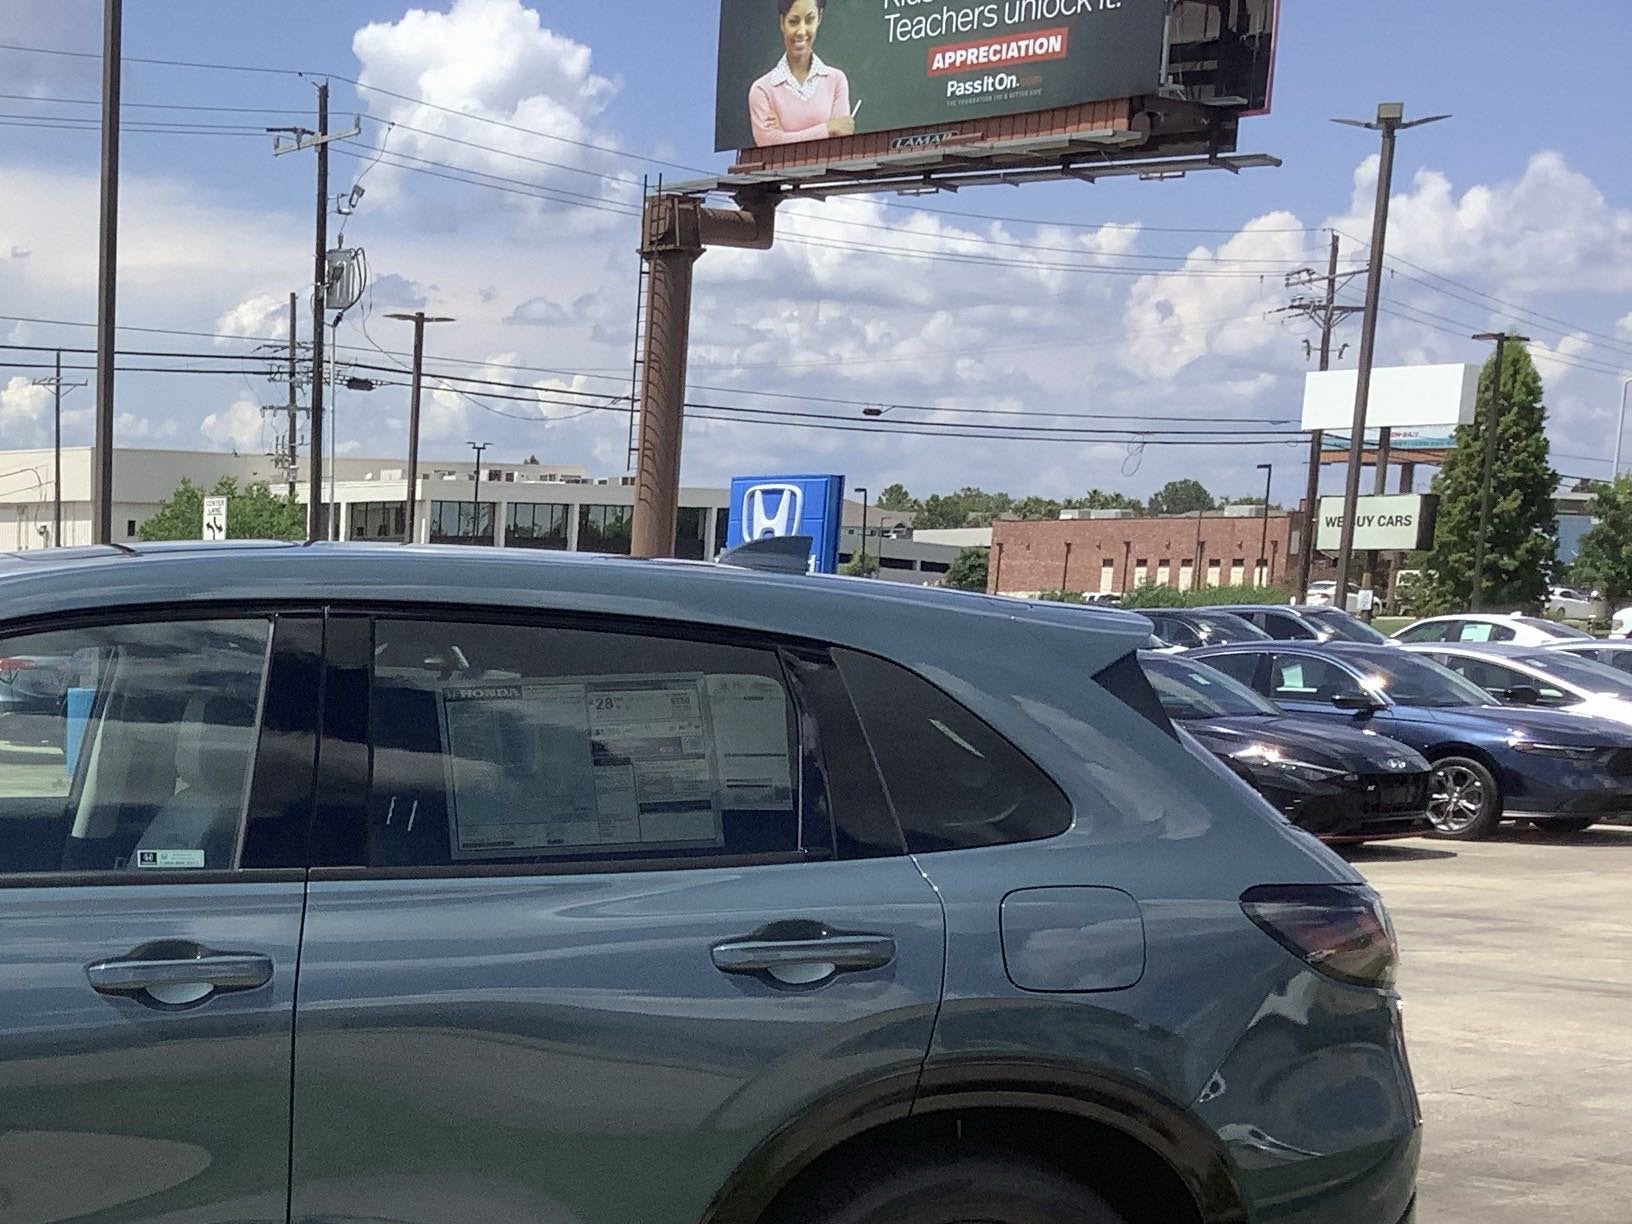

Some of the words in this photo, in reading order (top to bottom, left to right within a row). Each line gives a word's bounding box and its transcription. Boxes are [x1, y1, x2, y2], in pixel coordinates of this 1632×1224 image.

[884, 4, 997, 43] Teachers
[932, 35, 1063, 70] APPRECIATION
[947, 73, 1041, 97] PassItOn.
[1325, 516, 1344, 527] WE
[1352, 515, 1375, 528] UY
[1377, 515, 1412, 527] CARS
[460, 686, 522, 699] HONDA
[595, 697, 614, 711] 28
